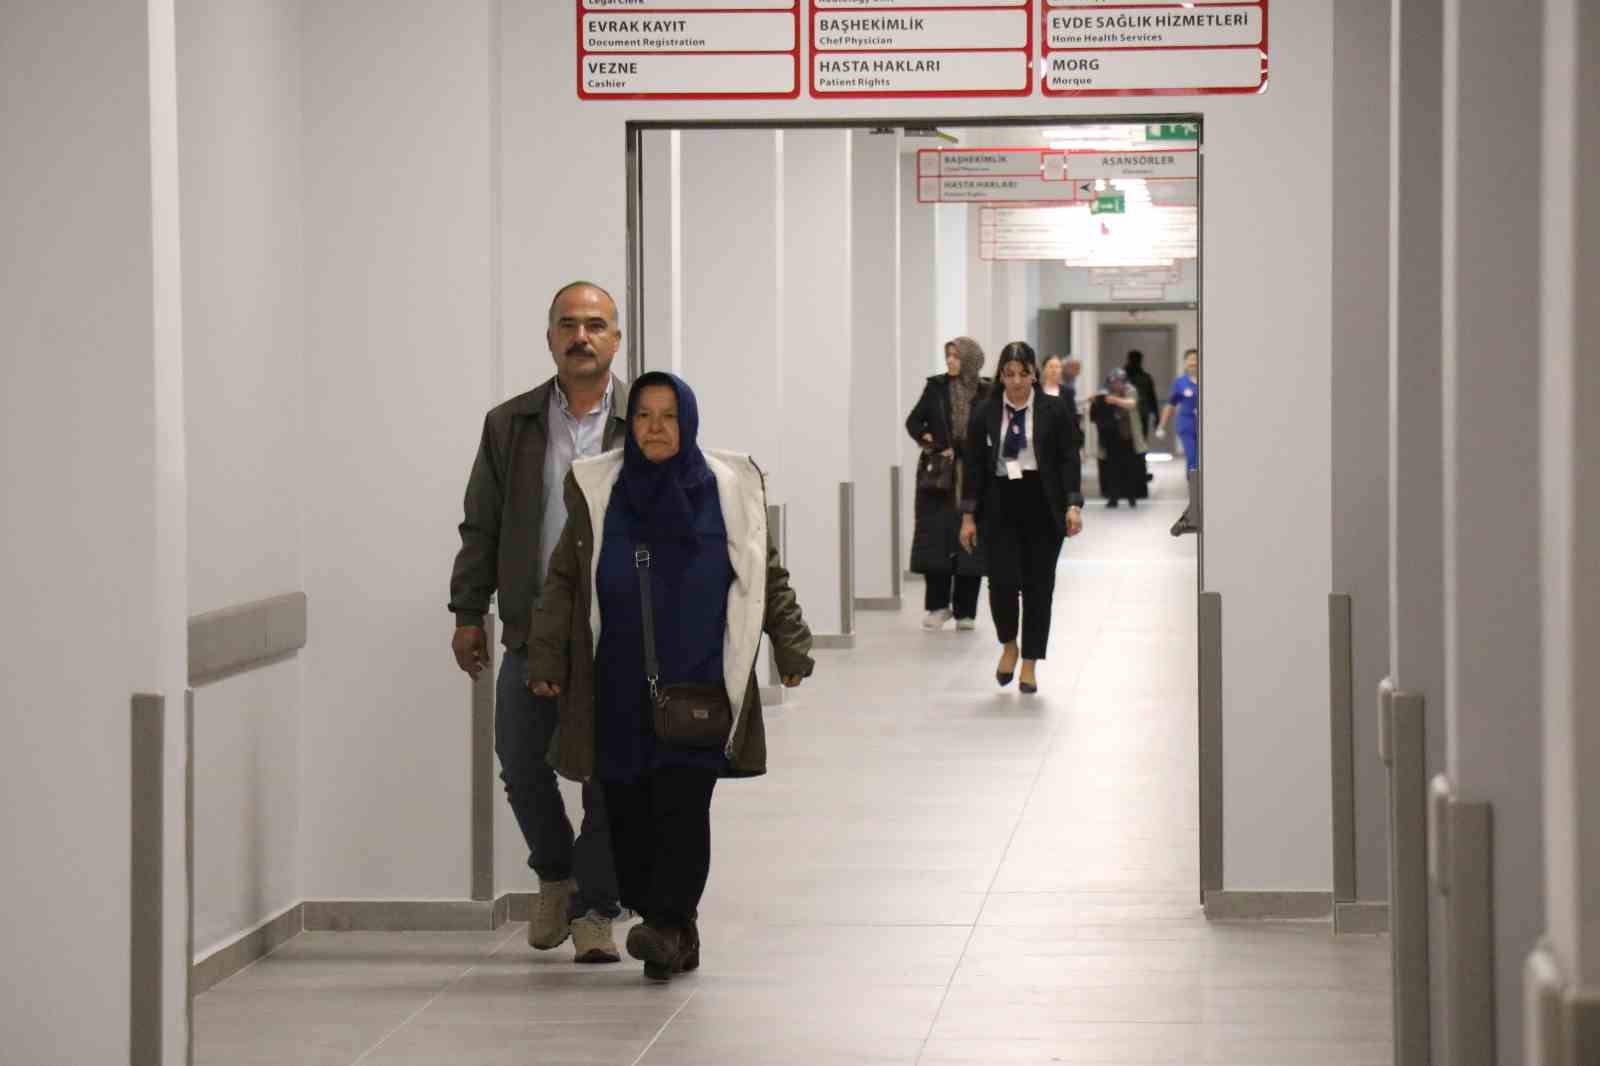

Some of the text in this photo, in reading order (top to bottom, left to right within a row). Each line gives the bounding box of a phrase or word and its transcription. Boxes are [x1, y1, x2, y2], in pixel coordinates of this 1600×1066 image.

[820, 16, 924, 33] BAŞHEKİMLİK
[1052, 12, 1248, 29] EVDE SAĞLIK HİZMETLERİ
[588, 21, 687, 32] EVRAK KAYIT
[588, 38, 705, 48] Document Registration
[820, 36, 893, 47] Chef Physician
[1052, 33, 1163, 43] Home Health Services
[588, 63, 638, 74] VEZNE
[820, 60, 941, 72] HASTA HAKLARI
[1052, 59, 1100, 70] MORG
[588, 79, 626, 88] Cashier
[820, 78, 890, 88] Patient Rights
